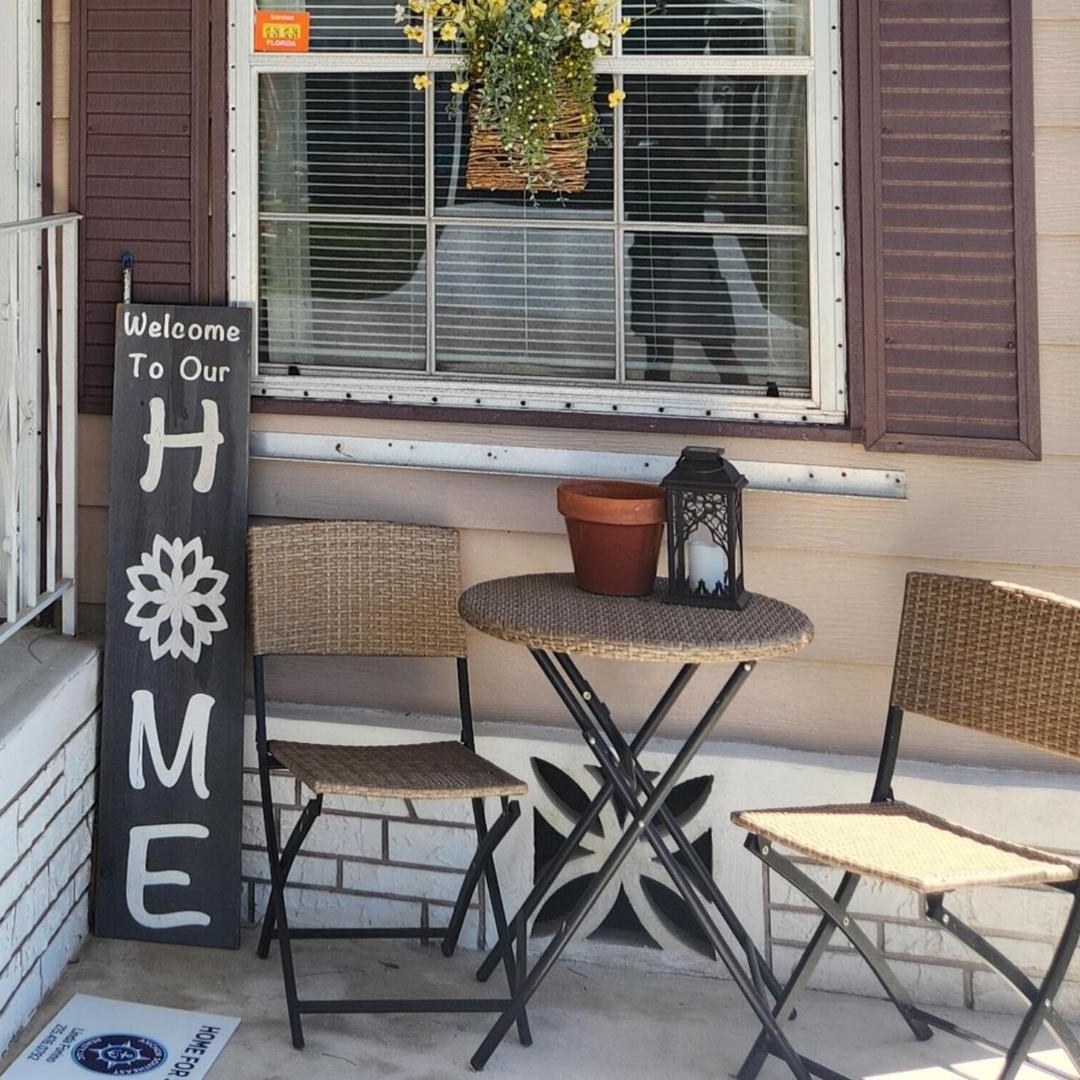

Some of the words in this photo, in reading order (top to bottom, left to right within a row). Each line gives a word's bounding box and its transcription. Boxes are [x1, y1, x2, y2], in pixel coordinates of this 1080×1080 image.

[266, 40, 297, 48] FLORIDA
[124, 311, 240, 342] Welcome
[128, 353, 164, 379] To
[179, 355, 230, 382] Our
[125, 397, 226, 928] HME
[184, 1025, 221, 1055] HOME
[168, 1055, 200, 1077] FOR
